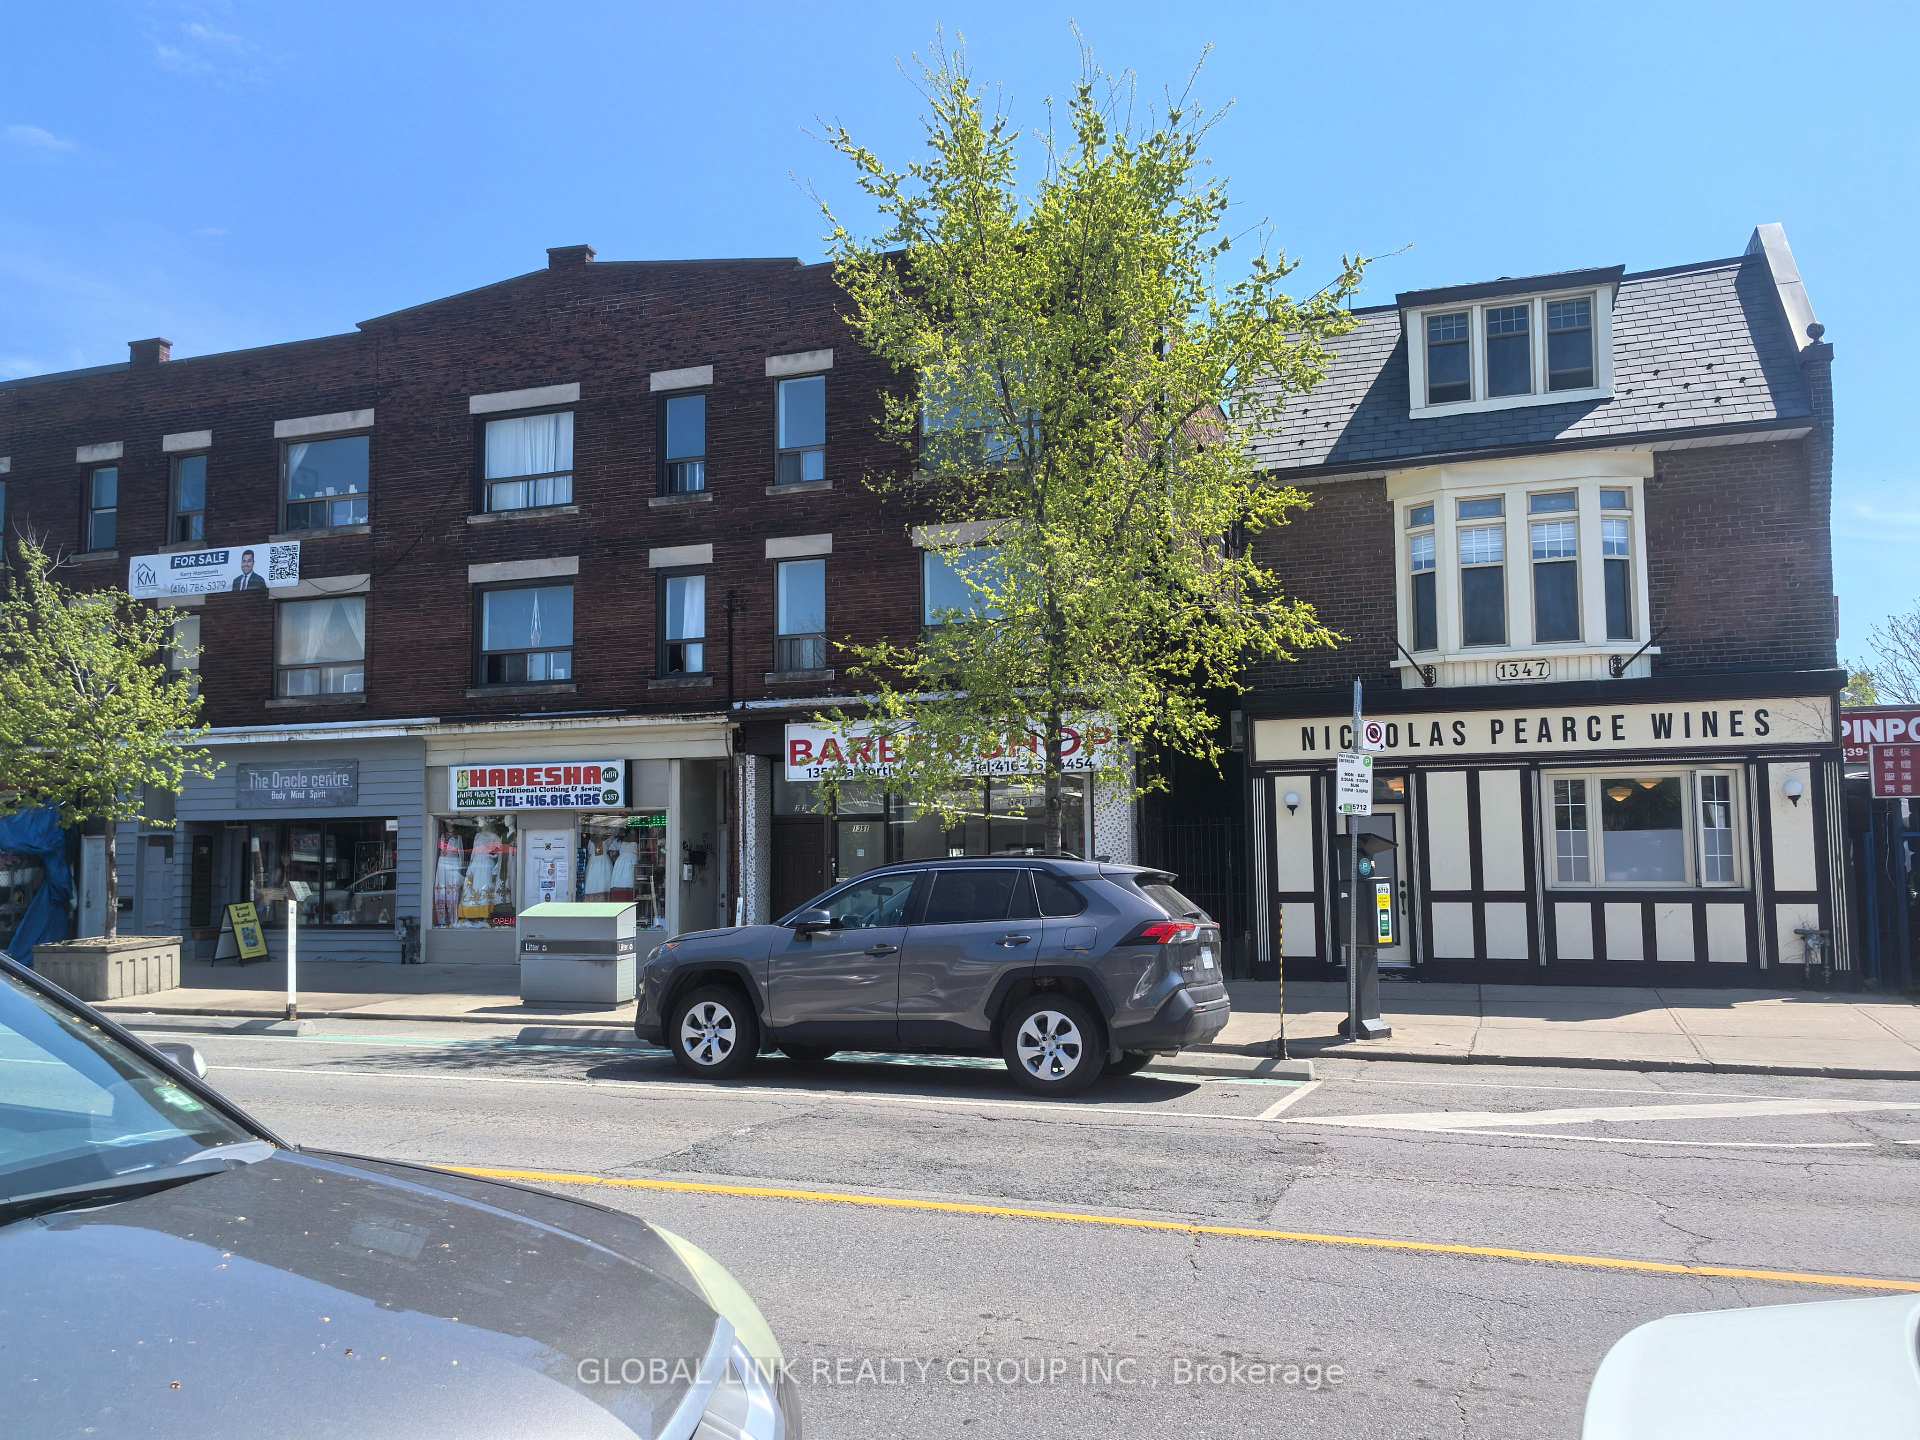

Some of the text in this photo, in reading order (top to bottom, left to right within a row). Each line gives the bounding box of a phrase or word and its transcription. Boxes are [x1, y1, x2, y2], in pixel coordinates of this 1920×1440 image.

[173, 552, 225, 568] FOR SALE
[137, 572, 157, 586] KM
[1500, 662, 1547, 678] 1347
[1302, 708, 1770, 750] NICOLAS PEARCE WINES
[249, 771, 350, 789] The Oracle centre
[469, 766, 602, 787] HABESHA
[271, 789, 326, 801] Body Mind Spirit
[497, 786, 537, 794] Traditional
[538, 785, 570, 794] Clothing
[497, 793, 600, 807] TEL: 416.816.1126
[1352, 803, 1367, 811] 5712
[525, 942, 539, 951] Litter
